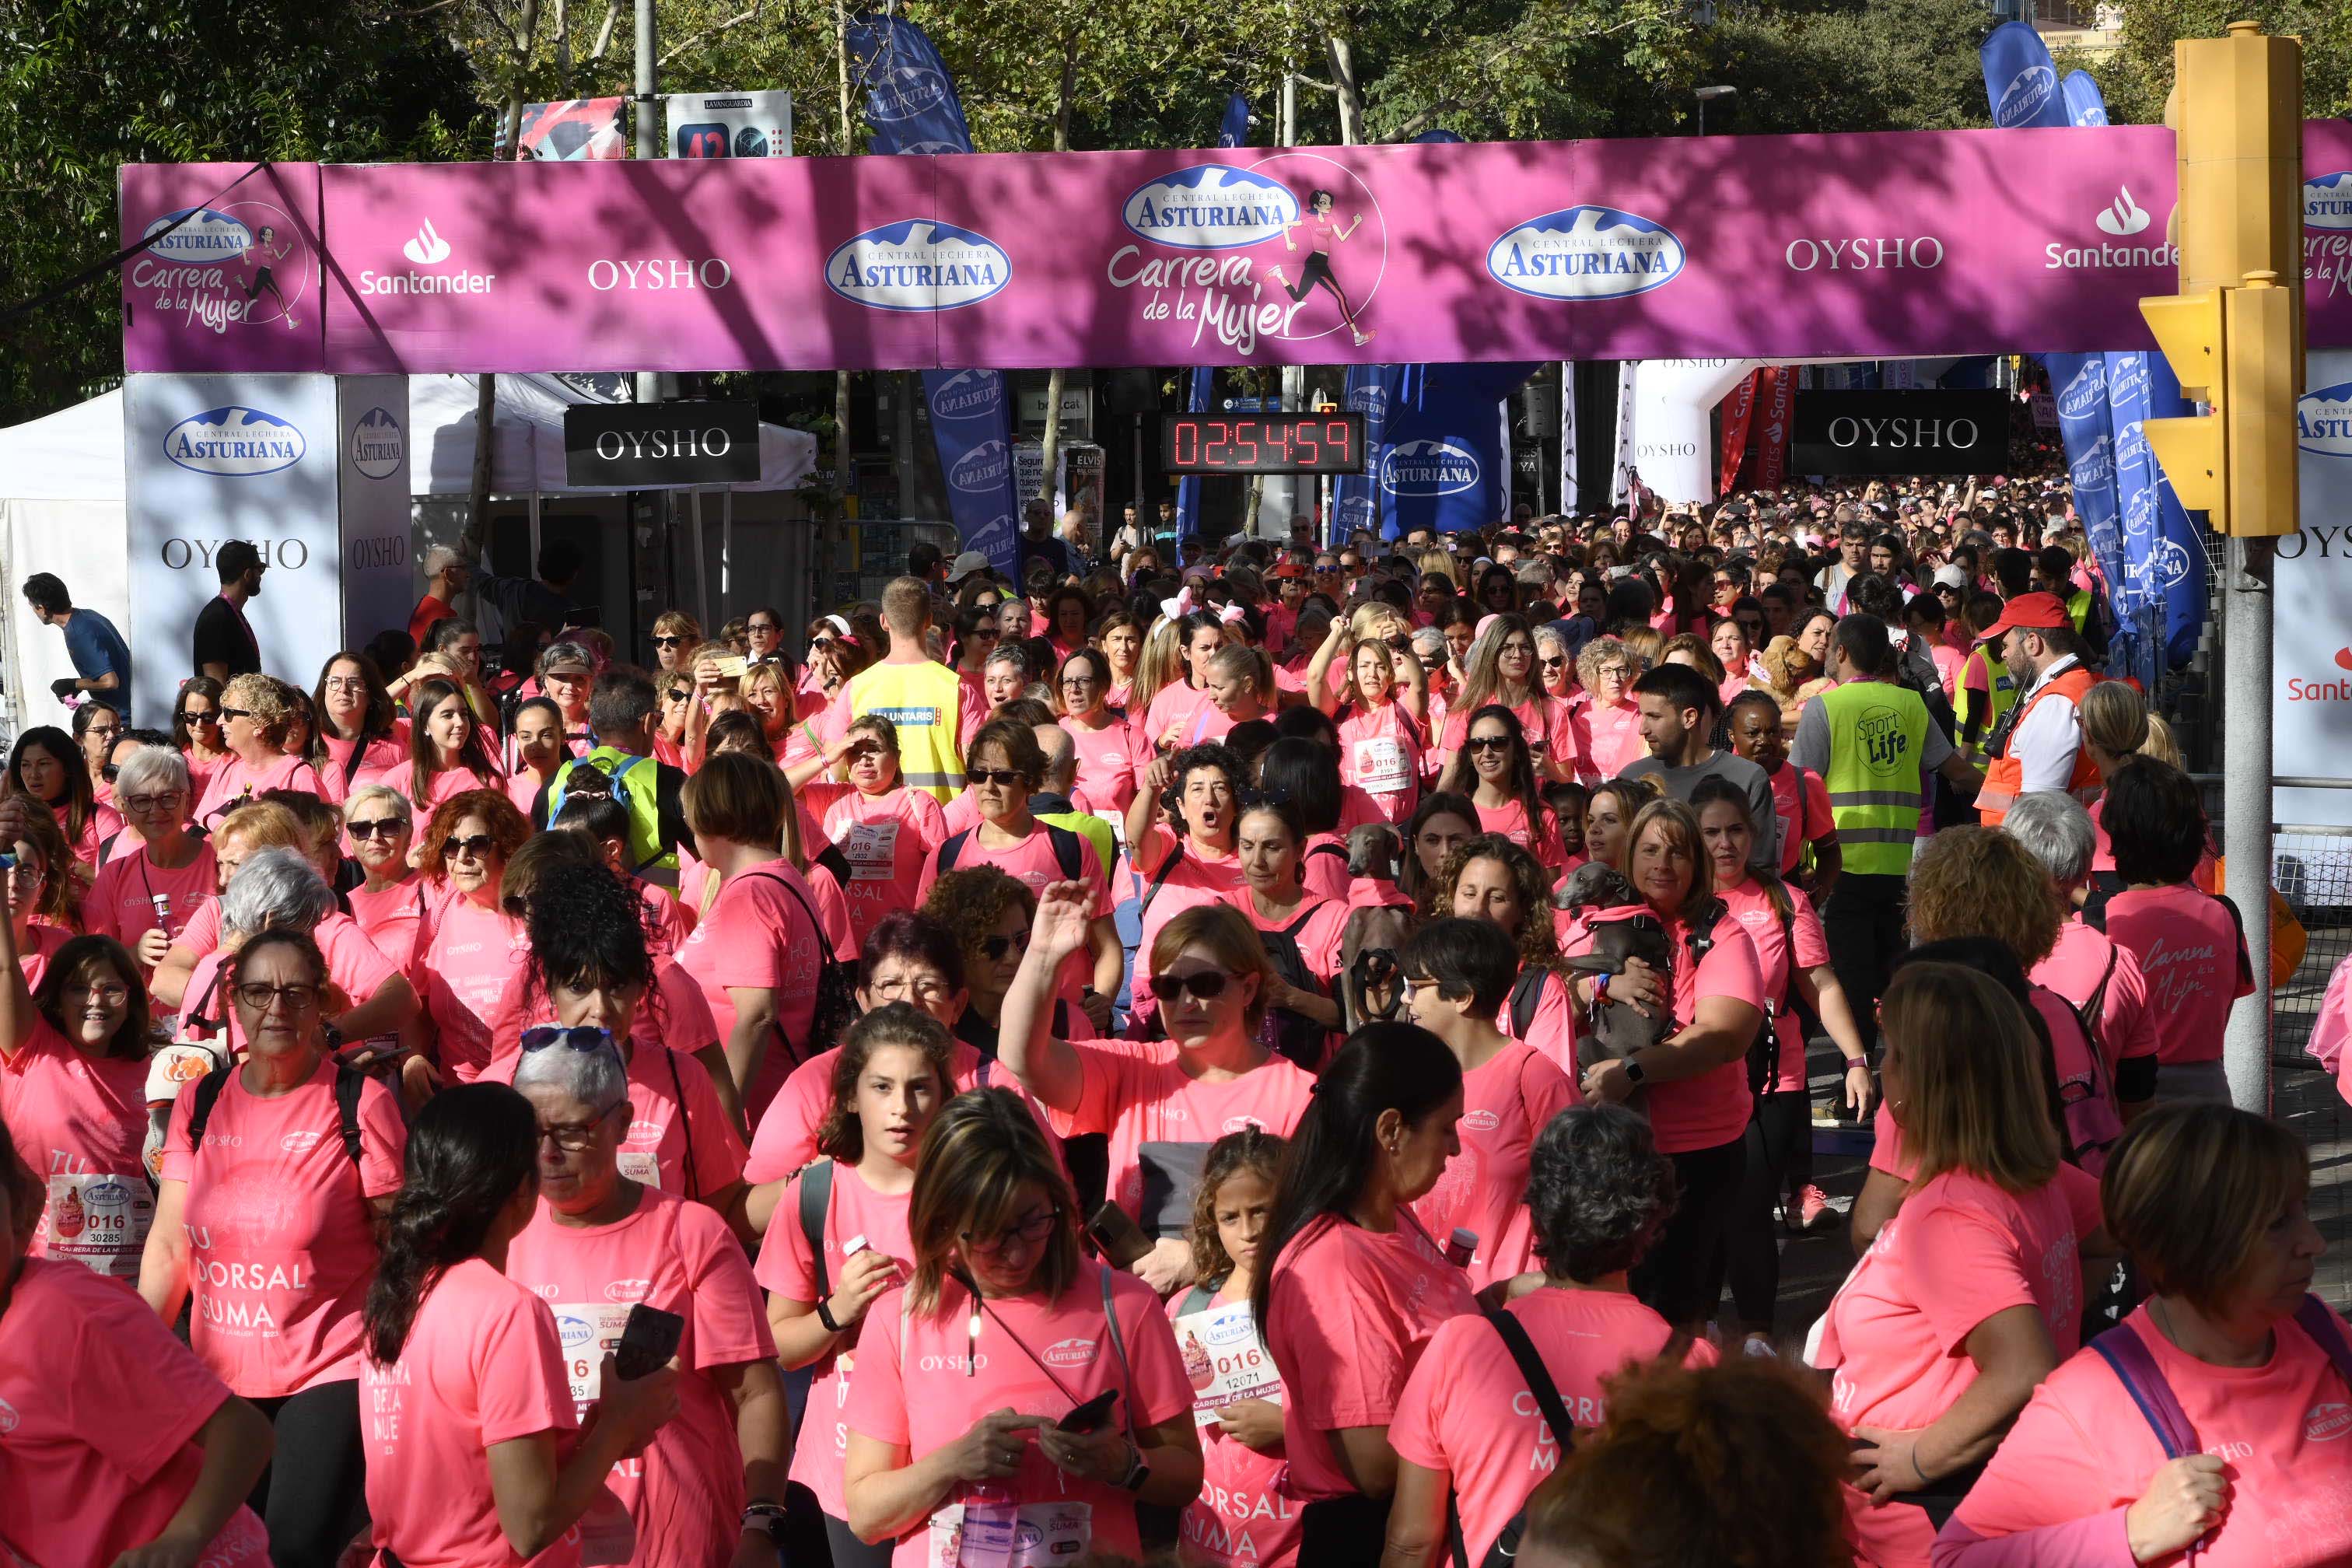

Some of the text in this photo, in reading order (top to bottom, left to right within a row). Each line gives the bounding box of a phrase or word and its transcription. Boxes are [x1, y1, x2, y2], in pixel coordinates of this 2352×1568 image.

[714, 99, 751, 108] VANGUARDIA
[1163, 192, 1279, 202] CENTRAL LECHERA
[1136, 196, 1285, 228] ASTURIANA
[868, 250, 990, 260] CENTRAL LECHERA
[1532, 236, 1663, 249] CENTRAL LECHERA
[1785, 236, 1944, 271] OYSHO
[2045, 242, 2179, 269] Santande
[839, 254, 997, 287] ASTURIANA
[1108, 244, 1252, 288] Carrera
[1502, 242, 1670, 277] ASTURIANA
[2317, 258, 2332, 280] la
[132, 260, 223, 289] Carrera
[360, 270, 495, 294] Santander
[588, 258, 730, 290] OYSHO
[155, 286, 258, 334] de la Mujer
[1143, 283, 1307, 355] de la Mujer
[175, 432, 296, 459] ASTURIANA
[595, 427, 731, 460] OYSHO
[1175, 422, 1349, 464] 02:54:59
[1829, 417, 1979, 449] OYSHO
[355, 435, 401, 462] ASTURIANA
[1077, 455, 1101, 465] ELVIS
[1637, 443, 1696, 458] OYSHO
[1384, 462, 1472, 485] ASTURIANA
[161, 538, 308, 570] OYHO
[353, 536, 404, 570] OYSHO
[1858, 711, 1900, 740] Sport
[1867, 730, 1906, 765] Life
[1376, 758, 1396, 767] 016
[851, 842, 871, 852] 016
[844, 882, 884, 901] RSAL
[2141, 937, 2216, 974] Carrera
[2153, 967, 2206, 1014] Mujer
[1464, 1116, 1498, 1127] ASTURIANA
[51, 1149, 86, 1175] TU
[88, 1192, 128, 1202] ASTURIANA
[88, 1214, 125, 1229] 016
[89, 1234, 121, 1243] 30285
[183, 1223, 212, 1250] TU
[196, 1257, 306, 1290] DORSAL
[201, 1293, 275, 1328] SUMA
[561, 1330, 589, 1339] RIANA
[1217, 1349, 1261, 1374] 016
[1226, 1372, 1260, 1390] 12071
[1193, 1395, 1230, 1409] CARRERA
[1244, 1390, 1255, 1398] LA
[1256, 1384, 1281, 1395] MUJER
[1199, 1479, 1293, 1520] ORSAL
[1049, 1521, 1079, 1531] SUMA
[1184, 1508, 1258, 1559] SUMA
